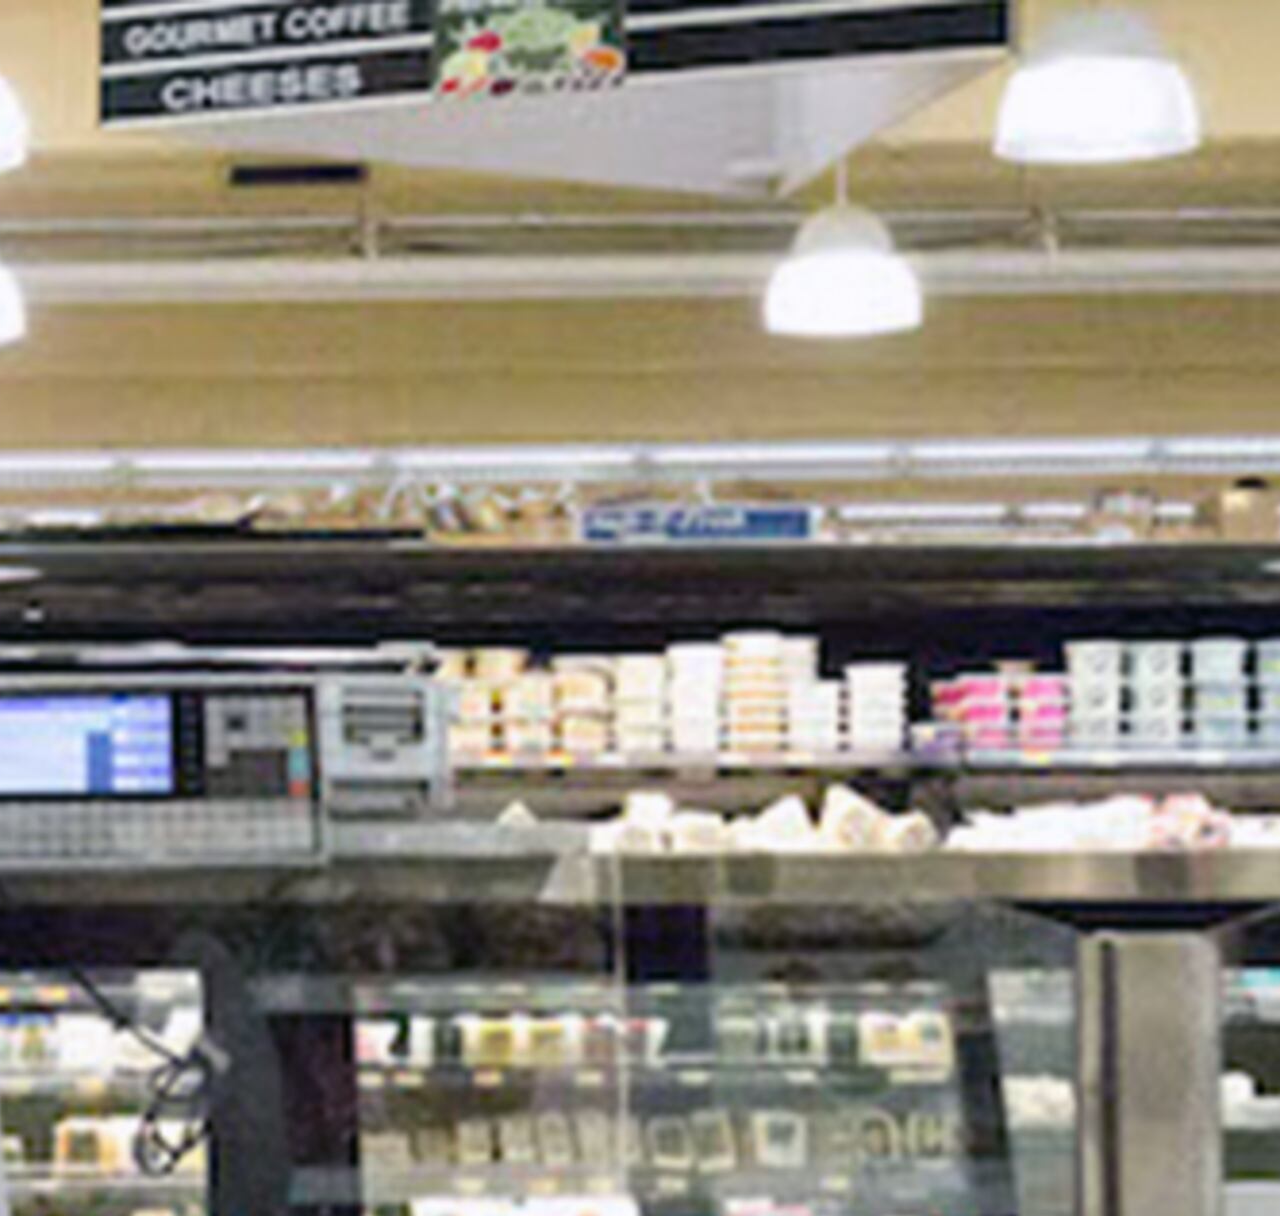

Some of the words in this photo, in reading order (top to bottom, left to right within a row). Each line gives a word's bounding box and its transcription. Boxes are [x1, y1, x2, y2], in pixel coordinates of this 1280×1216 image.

[124, 14, 278, 54] GOURMET
[284, 2, 411, 39] COFFEE
[162, 64, 363, 109] CHEESES
